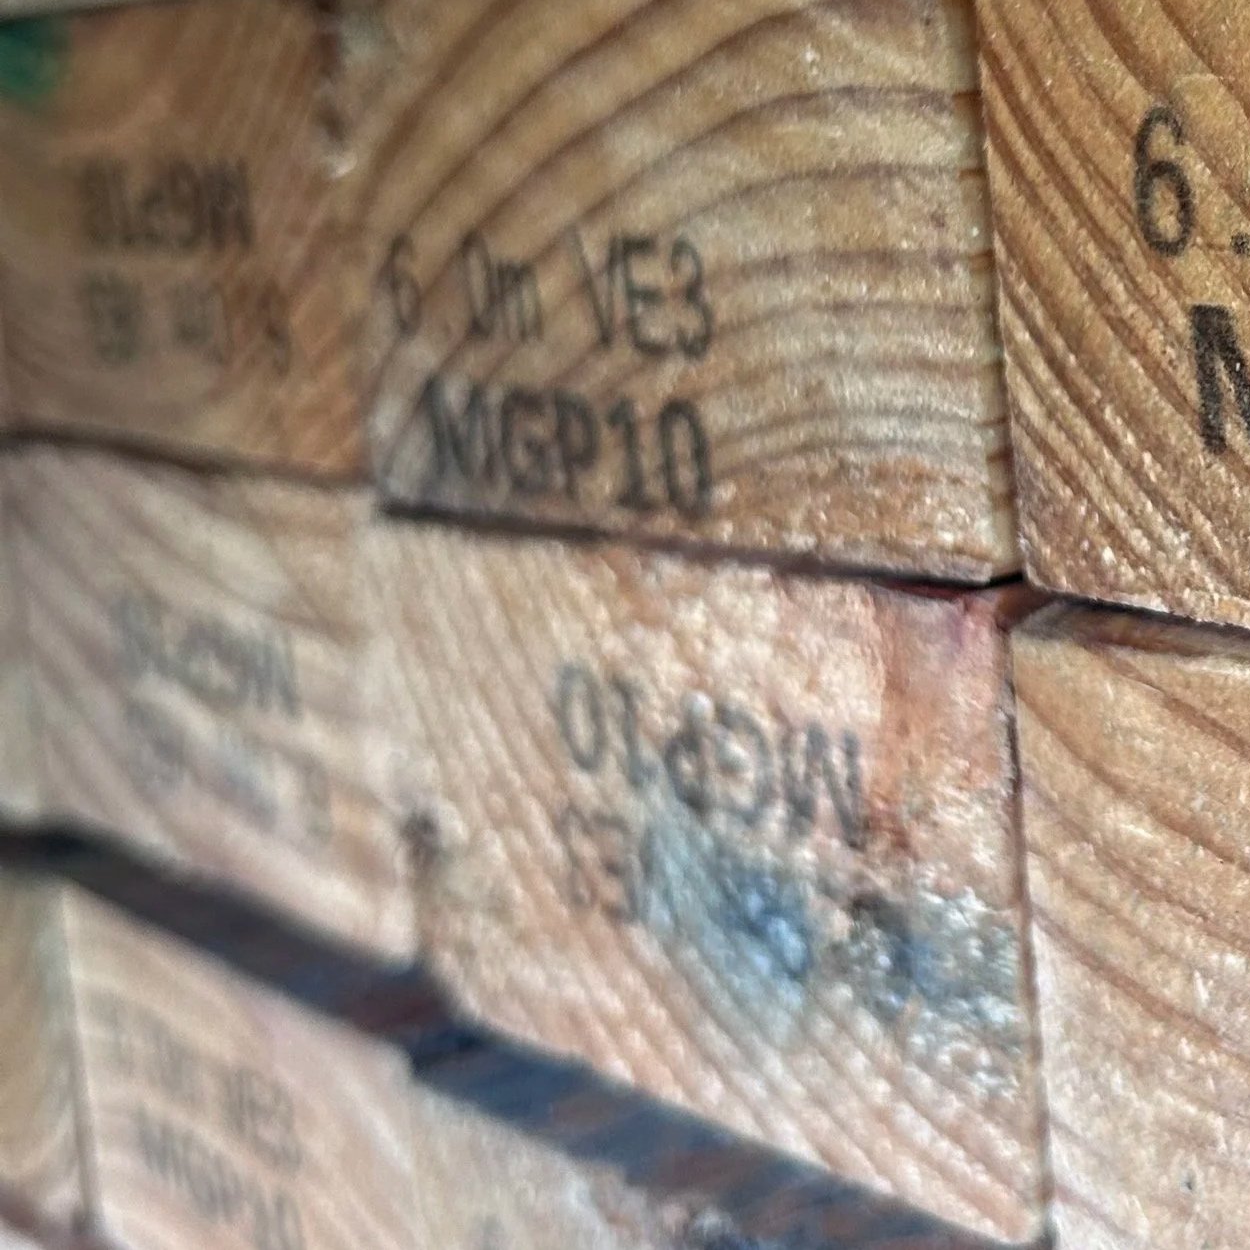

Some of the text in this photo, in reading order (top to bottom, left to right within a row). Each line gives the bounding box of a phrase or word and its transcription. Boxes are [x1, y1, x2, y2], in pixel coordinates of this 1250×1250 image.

[563, 223, 716, 360] VE3
[423, 372, 716, 518] MGP10
[555, 662, 867, 853] MGP10
